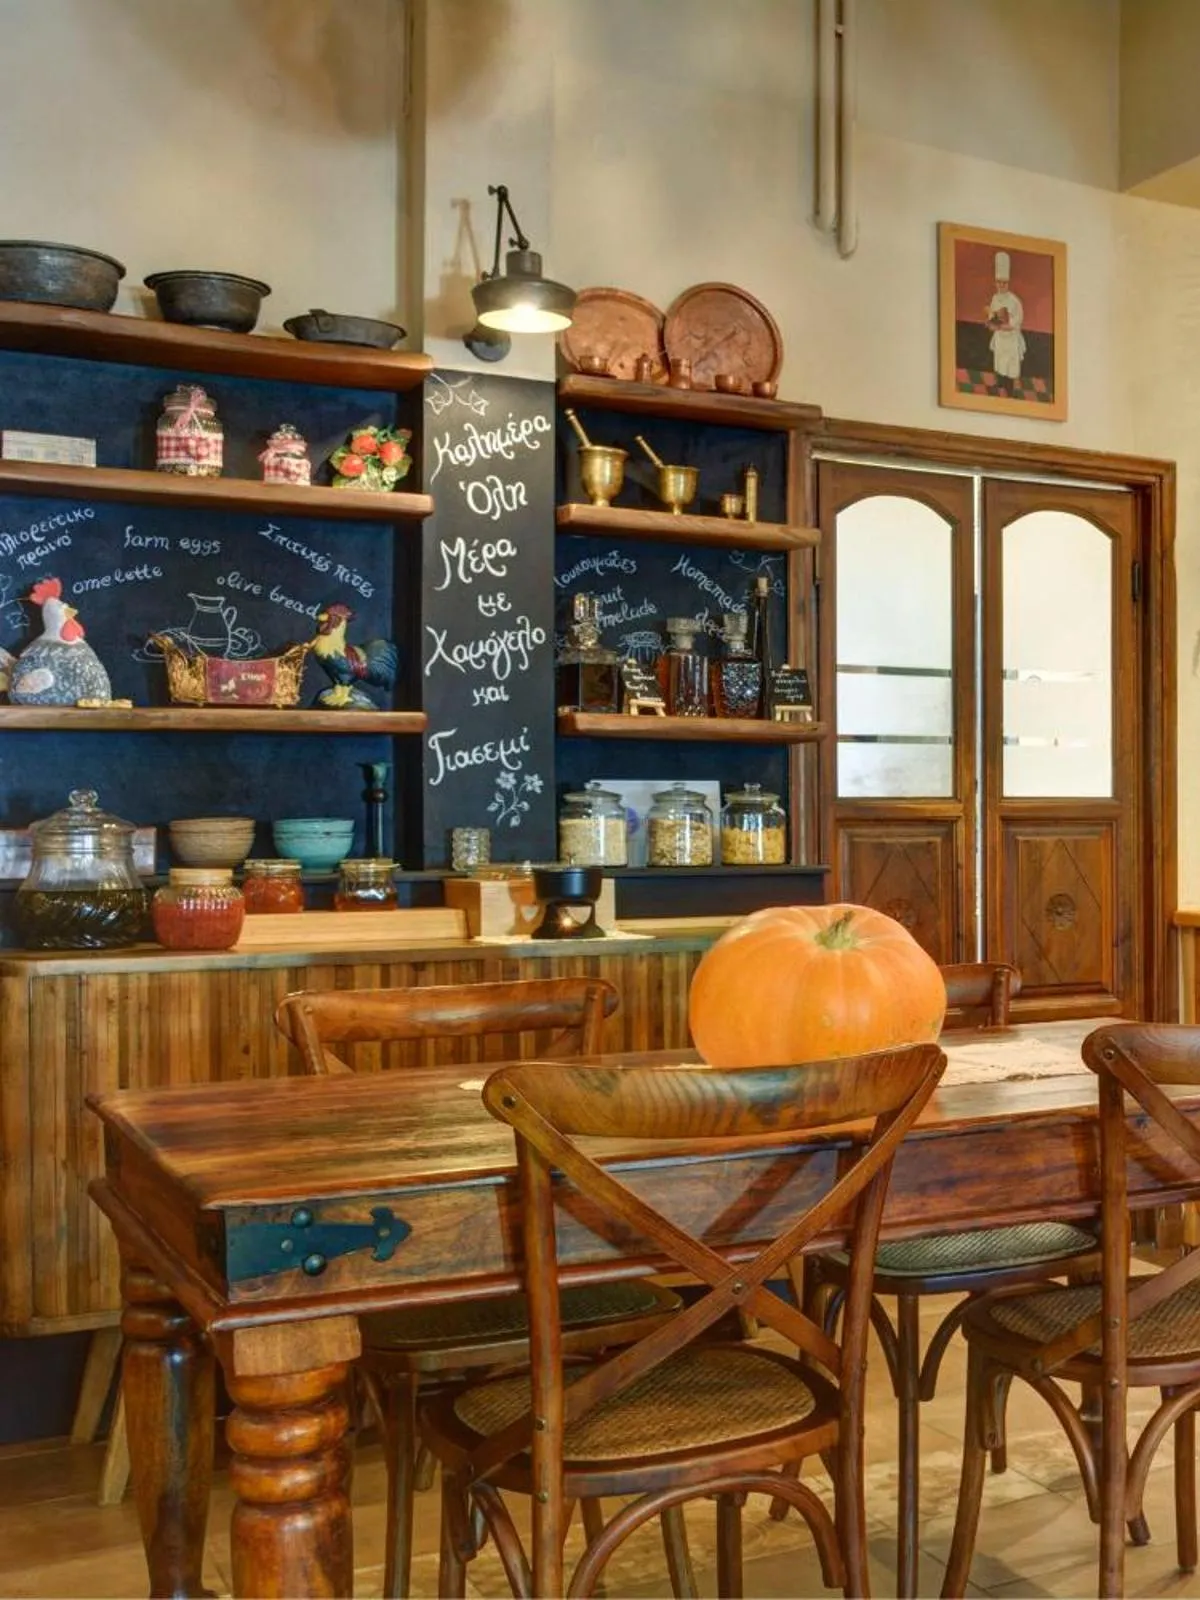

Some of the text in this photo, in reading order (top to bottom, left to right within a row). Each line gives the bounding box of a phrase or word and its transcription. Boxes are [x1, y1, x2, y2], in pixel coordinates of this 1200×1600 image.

[430, 413, 551, 485] Καλημέρα
[124, 525, 222, 556] farm eggs
[433, 537, 518, 591] Μέρα
[72, 564, 163, 594] omelette
[216, 571, 321, 620] olive bread
[477, 592, 512, 617] με
[425, 616, 546, 681] Χαμόγελο
[472, 686, 510, 707] και
[428, 727, 530, 786] Γιασεμί
